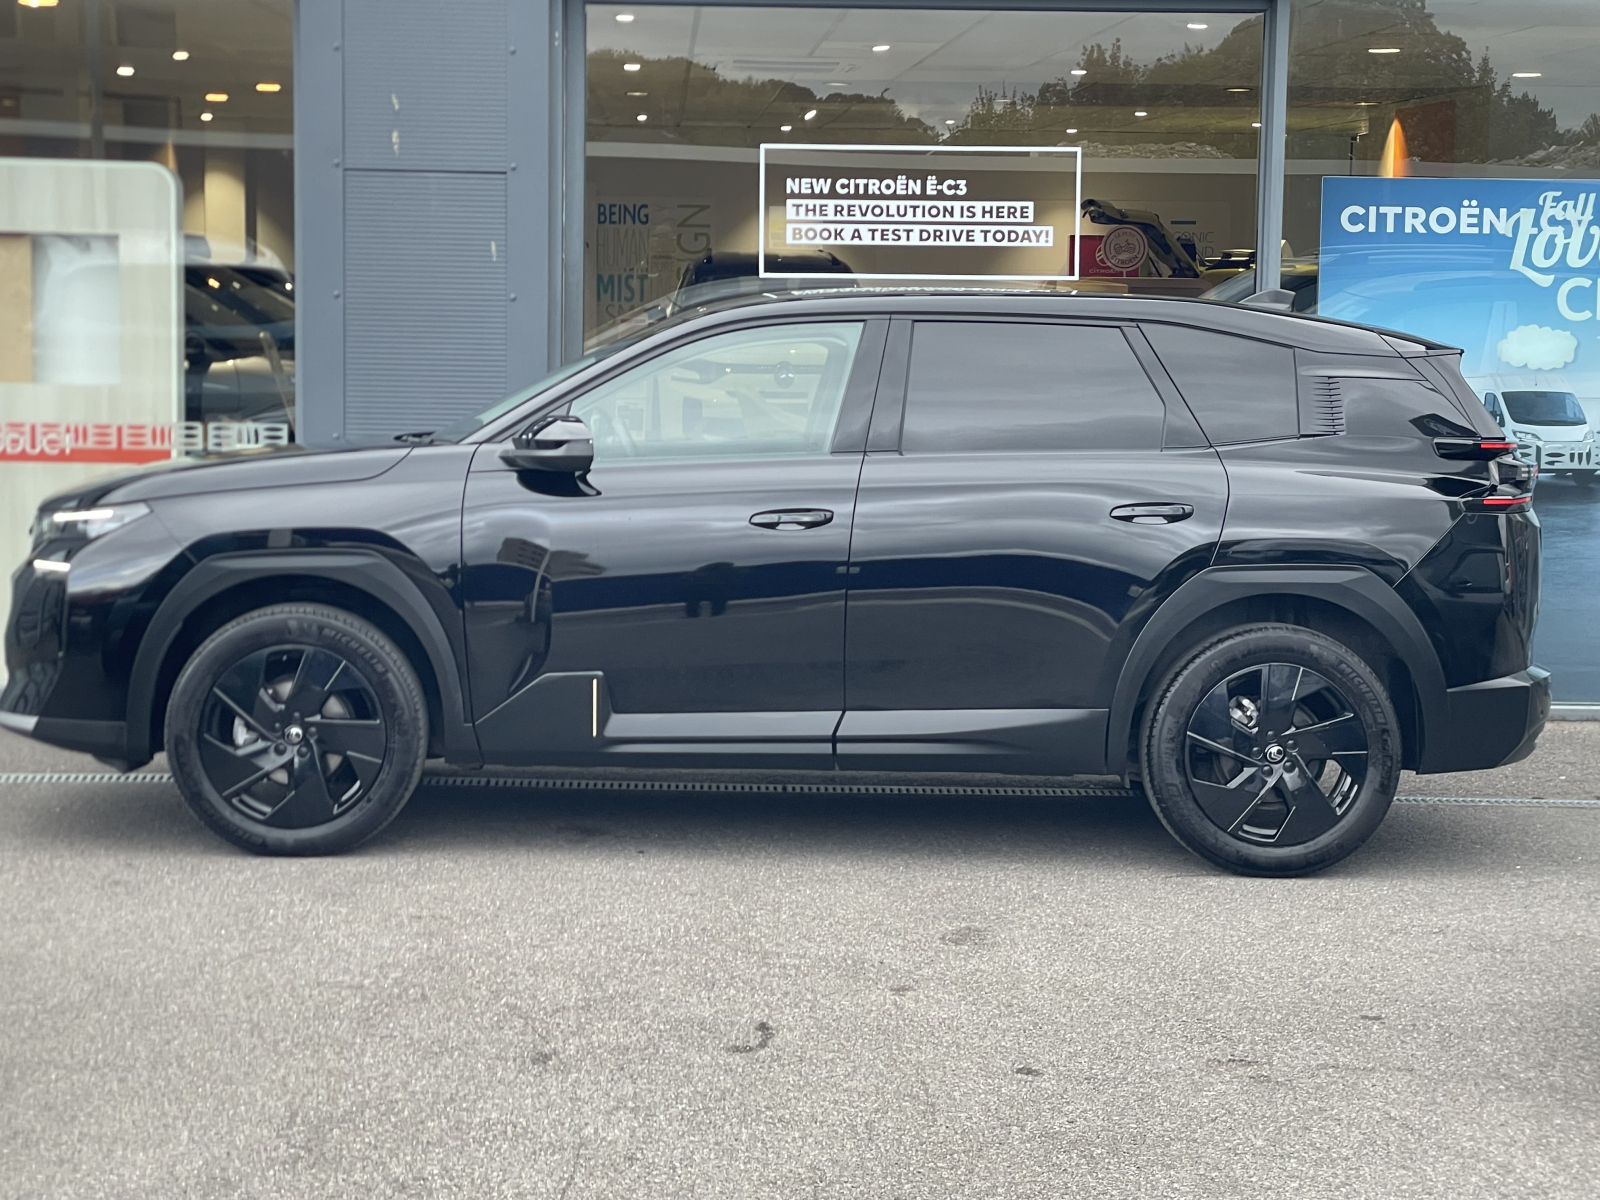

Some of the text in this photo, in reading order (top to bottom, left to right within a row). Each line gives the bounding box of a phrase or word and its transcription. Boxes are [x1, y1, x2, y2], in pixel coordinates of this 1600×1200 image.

[785, 174, 967, 196] NEW CITROËN Ë-C3
[597, 203, 649, 225] BEING
[792, 203, 1030, 220] THE REVOLUTION IS HERE
[1340, 199, 1506, 235] CITROËN
[1539, 190, 1597, 222] Fall
[596, 228, 650, 268] HUMAN
[792, 227, 1050, 243] BOOK A TEST DRIVE TODAY!
[1505, 206, 1600, 288] Lov
[596, 273, 649, 302] MIST
[321, 627, 387, 673] MICHELIN
[1337, 662, 1387, 725] MICHELIN
